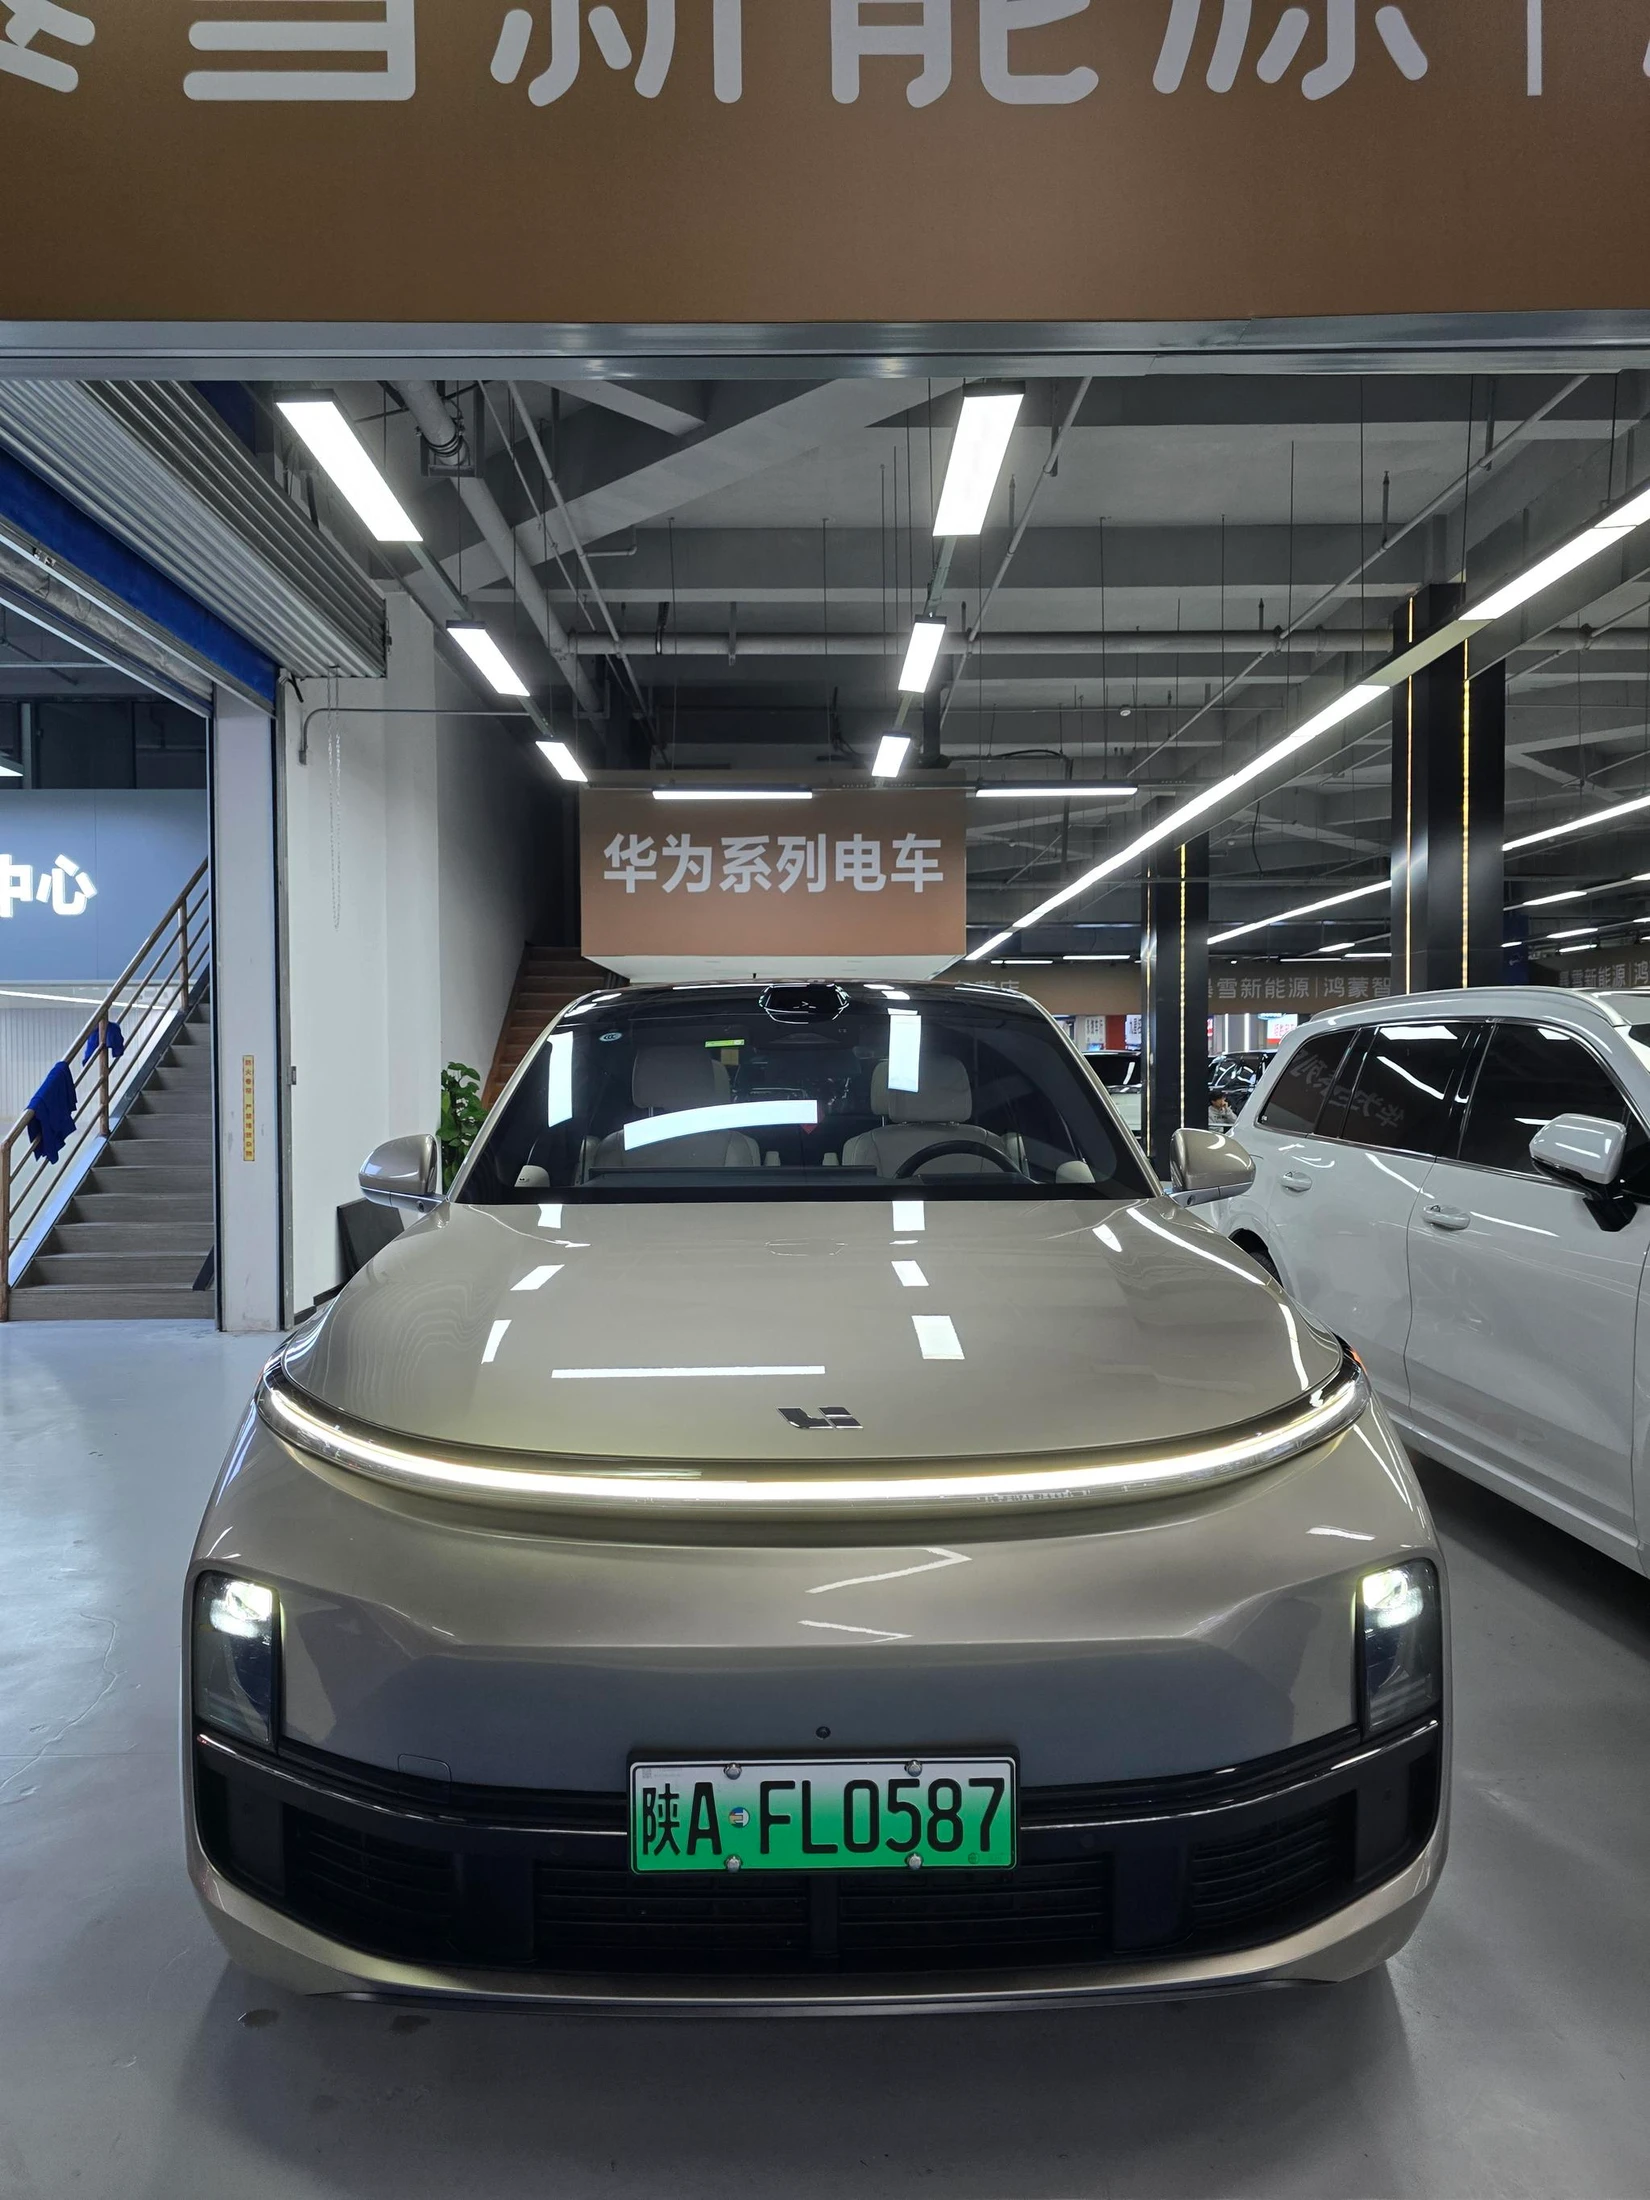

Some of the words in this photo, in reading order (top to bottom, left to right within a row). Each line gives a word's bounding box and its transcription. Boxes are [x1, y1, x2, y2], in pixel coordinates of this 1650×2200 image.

[0, 854, 98, 918] 中心
[603, 833, 944, 894] 华为系列电车
[1208, 977, 1310, 999] 雪新能源
[1324, 976, 1391, 997] 鸿蒙智
[642, 1781, 722, 1856] 陕A
[760, 1778, 1005, 1854] FL0587
